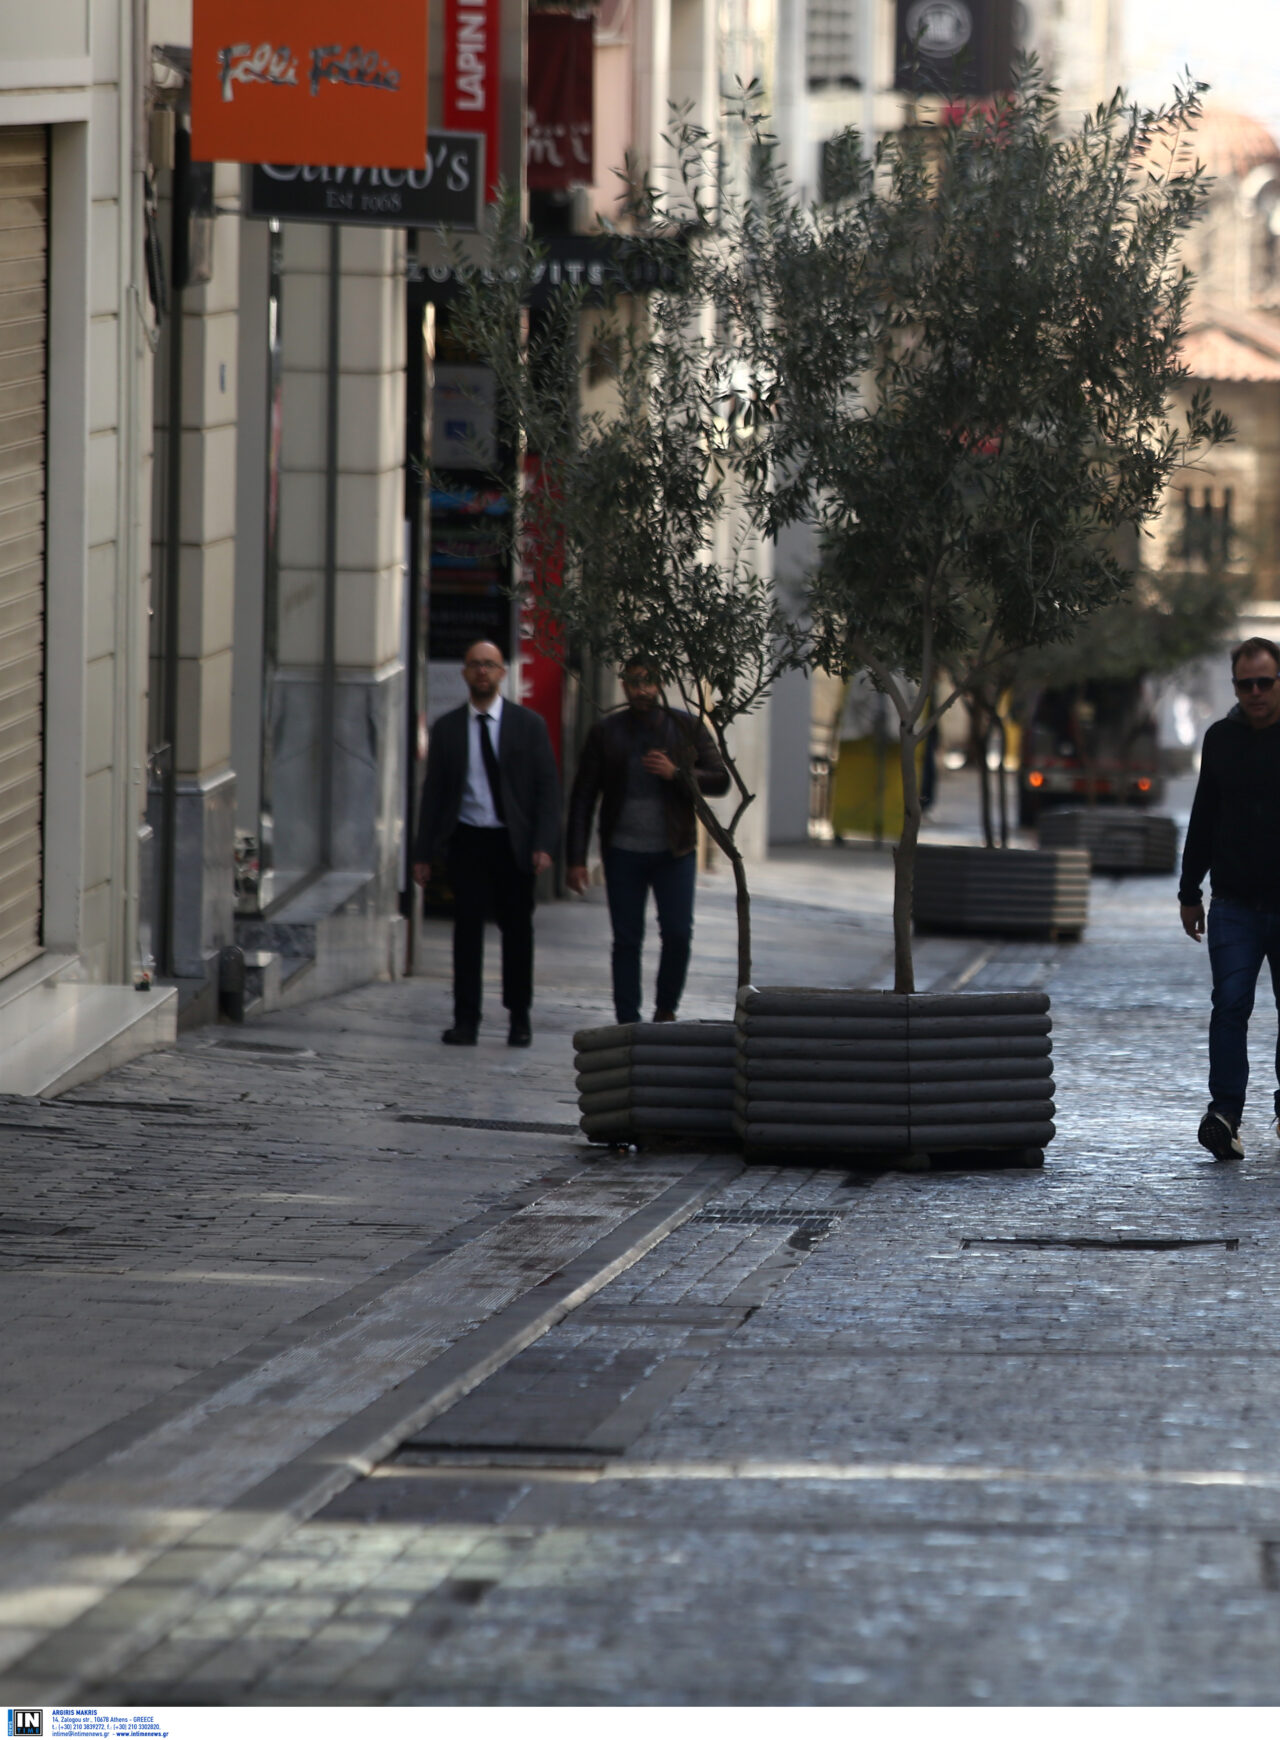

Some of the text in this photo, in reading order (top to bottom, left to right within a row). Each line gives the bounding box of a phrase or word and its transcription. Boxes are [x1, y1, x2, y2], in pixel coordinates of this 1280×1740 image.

[217, 43, 400, 102] Folli Follie
[456, 12, 486, 111] LAPIN
